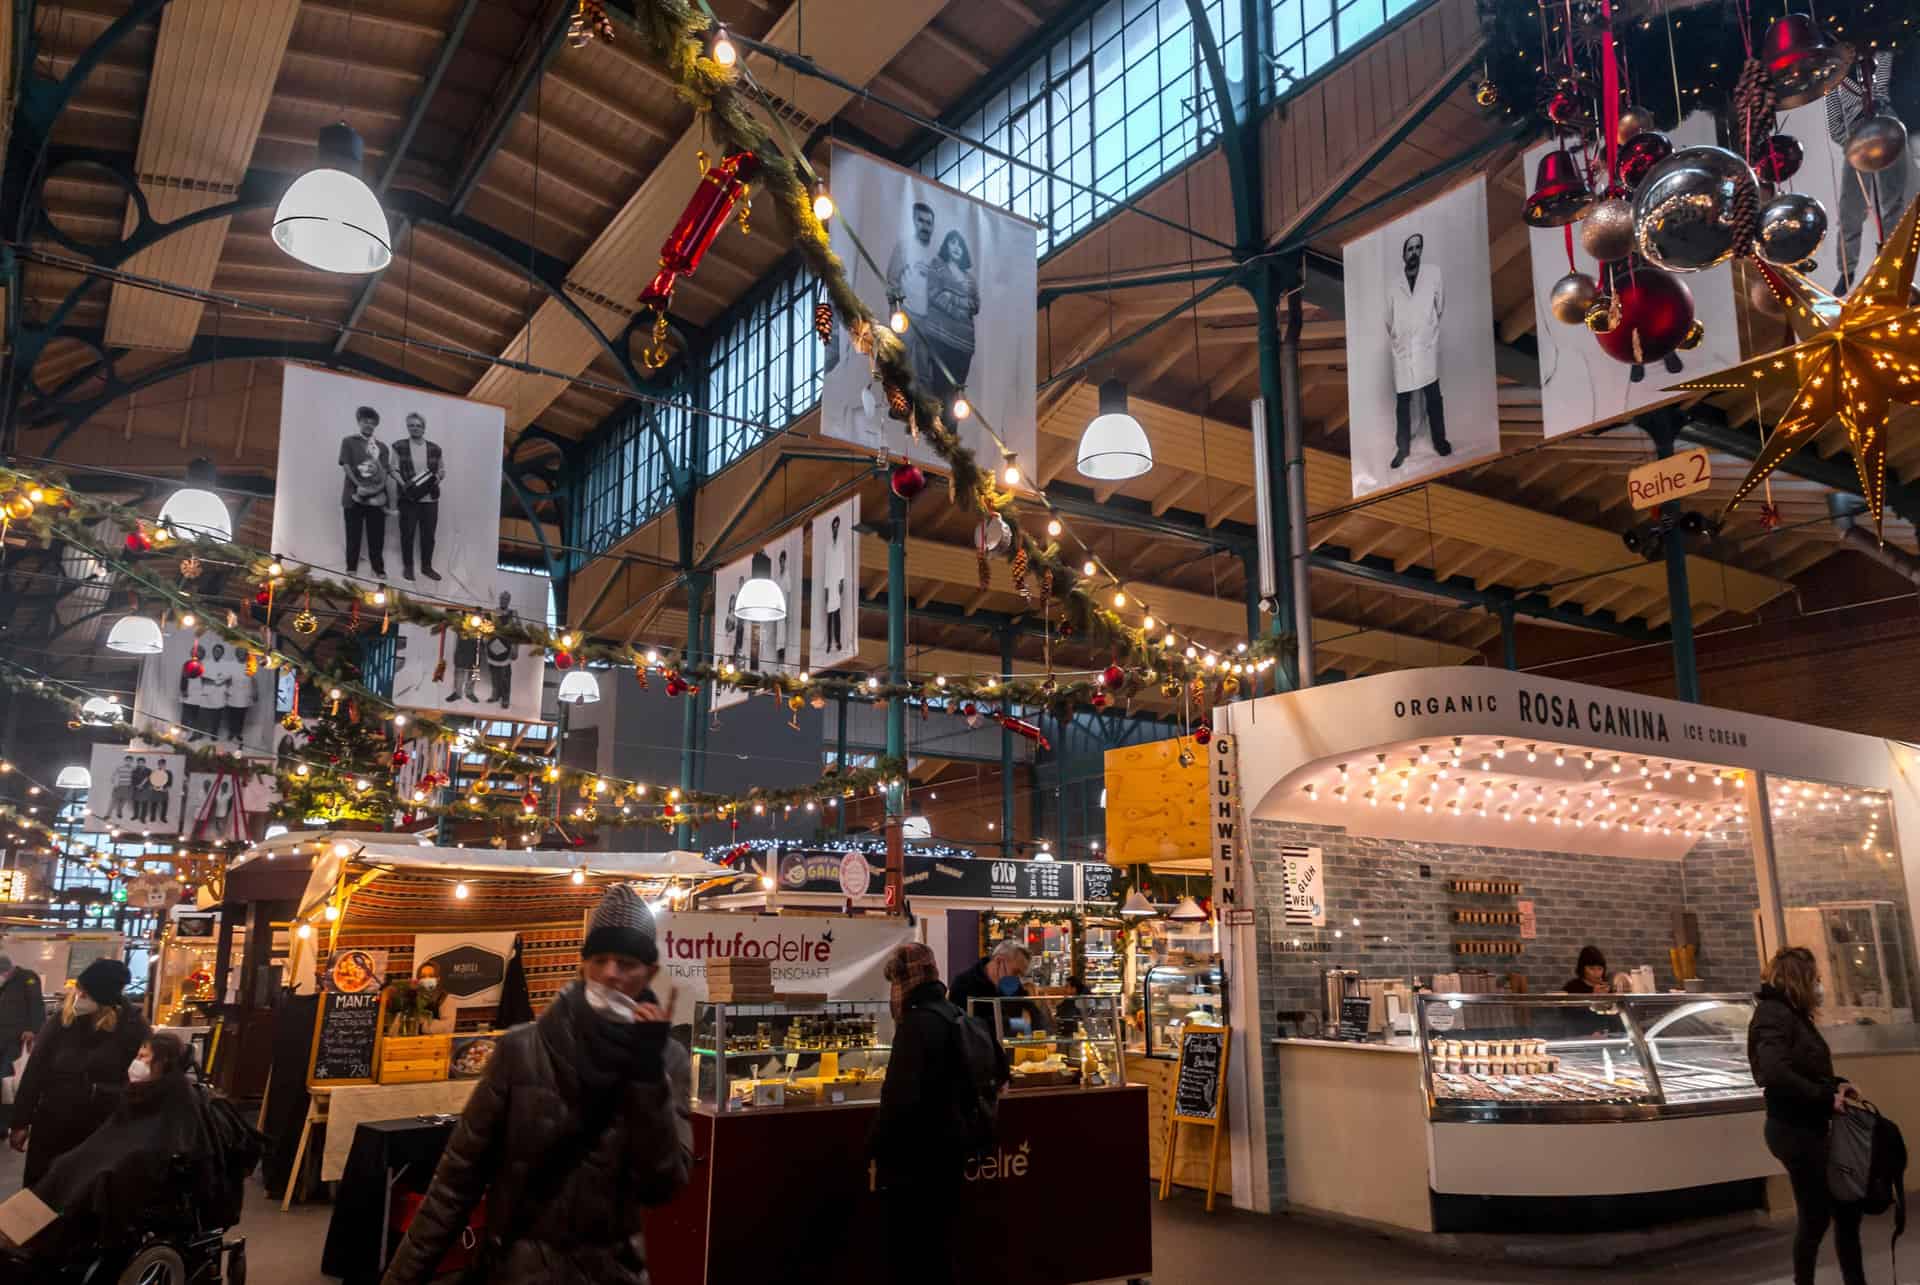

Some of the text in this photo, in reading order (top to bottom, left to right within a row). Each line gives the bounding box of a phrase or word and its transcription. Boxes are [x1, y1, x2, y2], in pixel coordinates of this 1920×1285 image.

[1629, 453, 1711, 505] Reihe 2
[1394, 689, 1748, 748] ORGANIC ROSA CANINA ICE CREAM
[1297, 865, 1316, 893] GLÜH
[1292, 895, 1314, 906] WEIN
